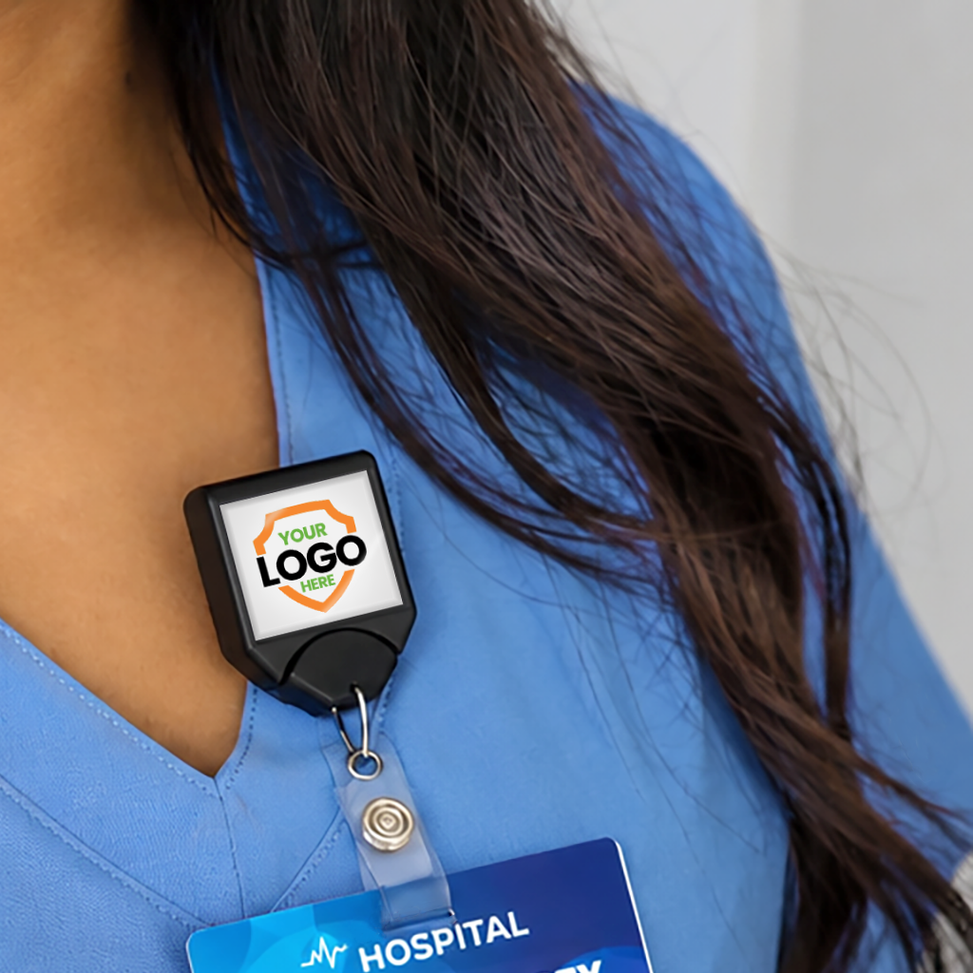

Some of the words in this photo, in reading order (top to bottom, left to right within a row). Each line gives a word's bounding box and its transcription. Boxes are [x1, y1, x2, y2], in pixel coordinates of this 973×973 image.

[278, 522, 328, 546] YOUR
[256, 535, 367, 587] LOGO
[300, 574, 336, 593] HERE
[358, 911, 530, 973] HOSPITAL
